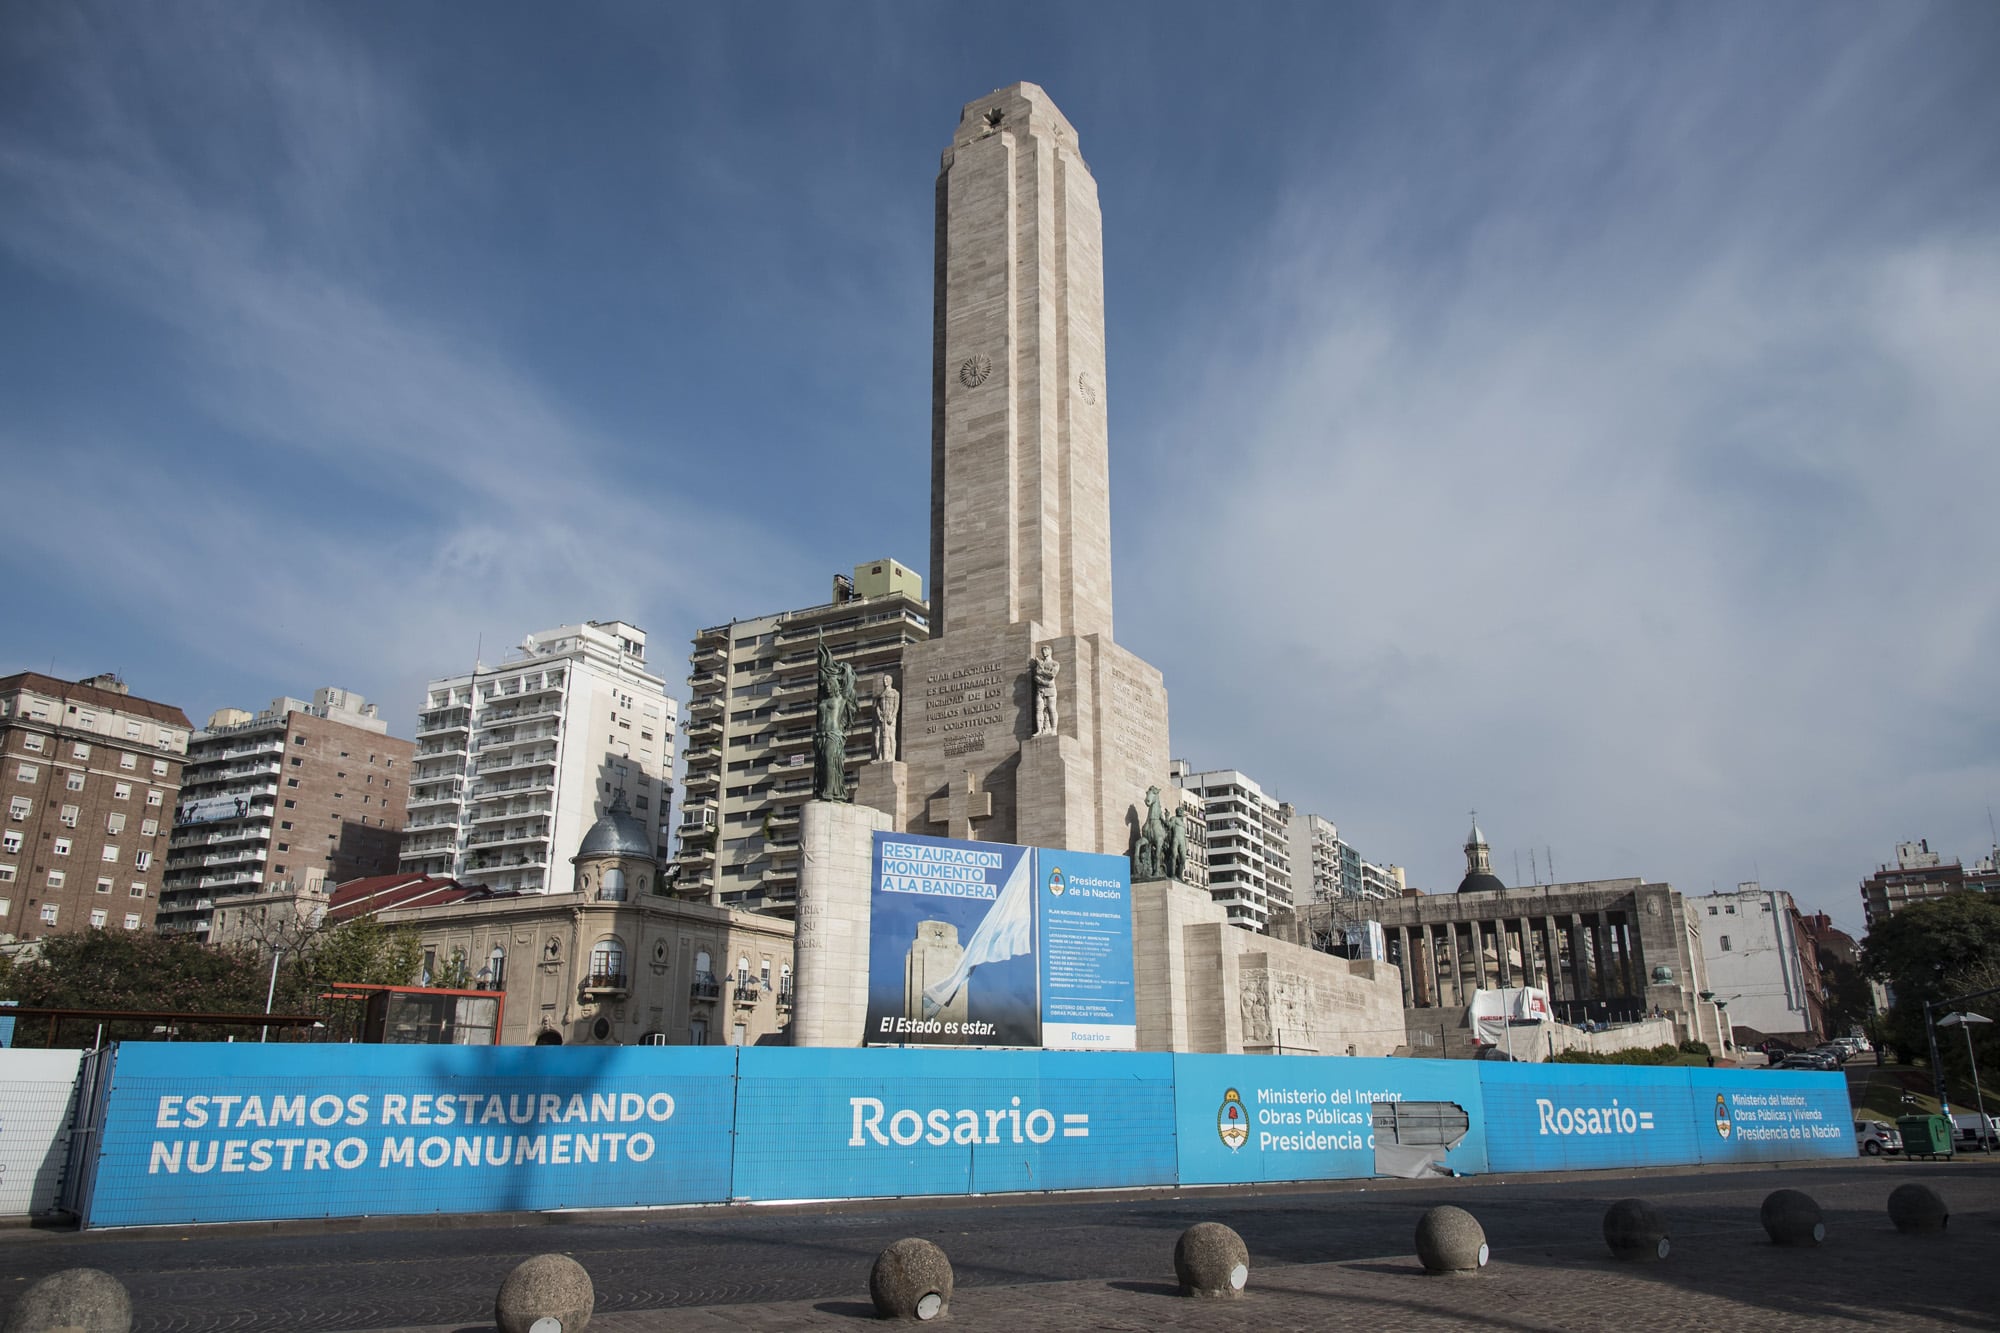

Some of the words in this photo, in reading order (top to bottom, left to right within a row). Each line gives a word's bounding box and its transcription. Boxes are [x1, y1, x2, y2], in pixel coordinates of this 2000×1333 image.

[939, 686, 949, 695] EL
[991, 675, 1002, 685] LA
[968, 693, 981, 702] DE
[985, 688, 1001, 699] LOS
[927, 725, 937, 734] SU
[883, 861, 983, 881] MONUMENTO
[883, 876, 894, 889] A
[899, 878, 917, 891] LA
[922, 880, 996, 898] BANDERA
[1070, 875, 1121, 888] Presidencia
[1069, 887, 1080, 896] de
[1082, 888, 1089, 897] la
[1092, 889, 1120, 899] Nación
[880, 1016, 894, 1033] El
[896, 1017, 941, 1034] Estado
[944, 1021, 959, 1034] es
[961, 1020, 996, 1036] estar.
[1257, 1088, 1327, 1104] Ministerio
[1331, 1088, 1352, 1104] del
[1732, 1094, 1767, 1105] Ministerio
[1768, 1094, 1779, 1105] del
[1780, 1094, 1807, 1107] Interior,
[156, 1094, 368, 1128] ESTAMOS
[382, 1092, 675, 1125] RESTAURANDO
[1259, 1108, 1302, 1125] Obras
[1306, 1109, 1363, 1124] Públicas
[1734, 1109, 1756, 1121] Obras
[1758, 1109, 1787, 1121] Públicas
[1788, 1111, 1792, 1122] y
[1793, 1109, 1822, 1120] Vivienda
[1736, 1125, 1788, 1141] Presidencia
[1789, 1124, 1800, 1139] de
[1801, 1124, 1811, 1138] la
[1812, 1123, 1840, 1138] Nación
[1260, 1131, 1363, 1151] Presidencia
[148, 1136, 366, 1173] NUESTRO
[379, 1132, 655, 1168] MONUMENTO
